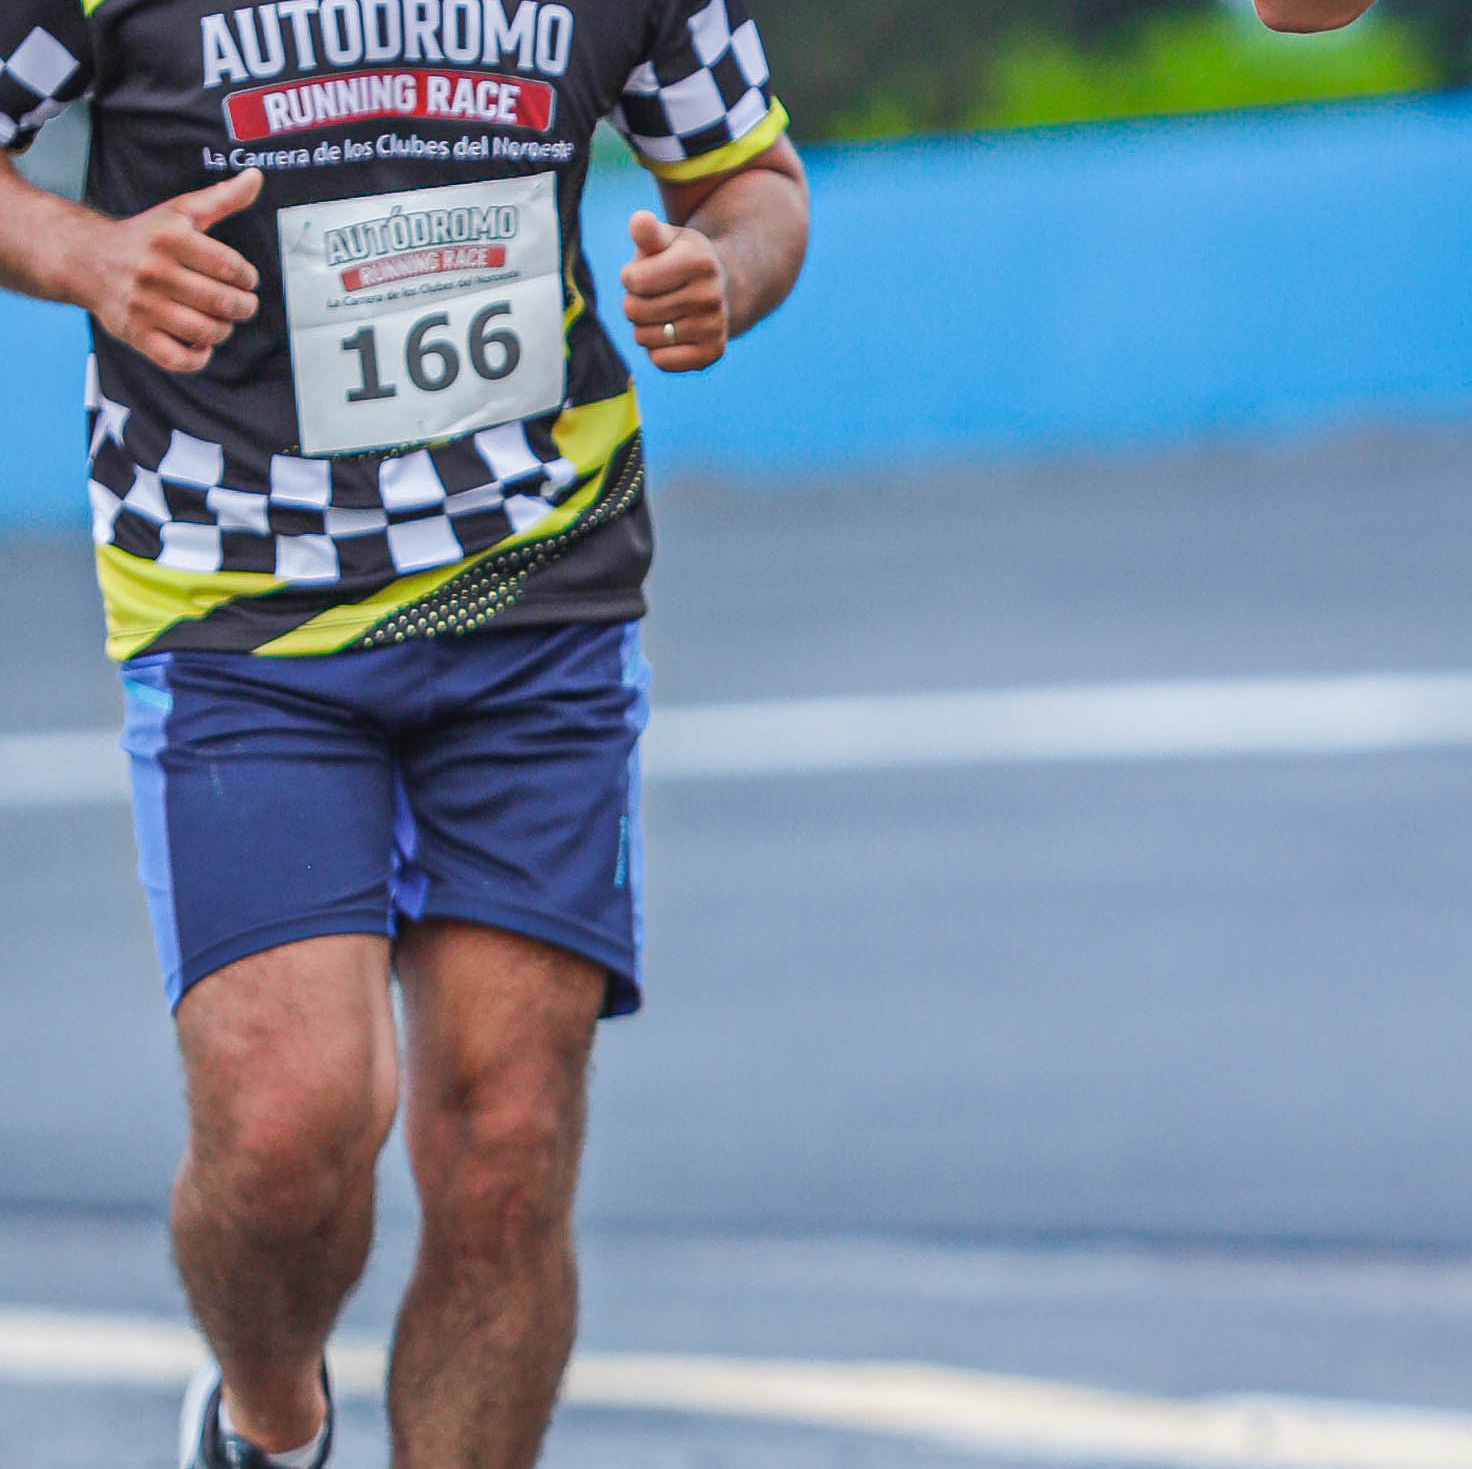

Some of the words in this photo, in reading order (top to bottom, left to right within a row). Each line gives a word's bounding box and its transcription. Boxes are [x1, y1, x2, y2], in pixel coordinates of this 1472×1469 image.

[262, 74, 418, 133] RUNNING
[425, 74, 522, 125] RACE
[203, 146, 227, 170] La
[229, 147, 311, 171] Carrera
[313, 140, 342, 165] de
[343, 138, 374, 163] los
[376, 133, 450, 159] Clubes
[453, 135, 489, 160] del
[492, 136, 575, 162] Noroeste
[324, 205, 517, 267] AUTÓDROMO
[361, 249, 439, 288] RUNNING
[443, 245, 489, 269] RACE
[340, 299, 520, 402] 166
